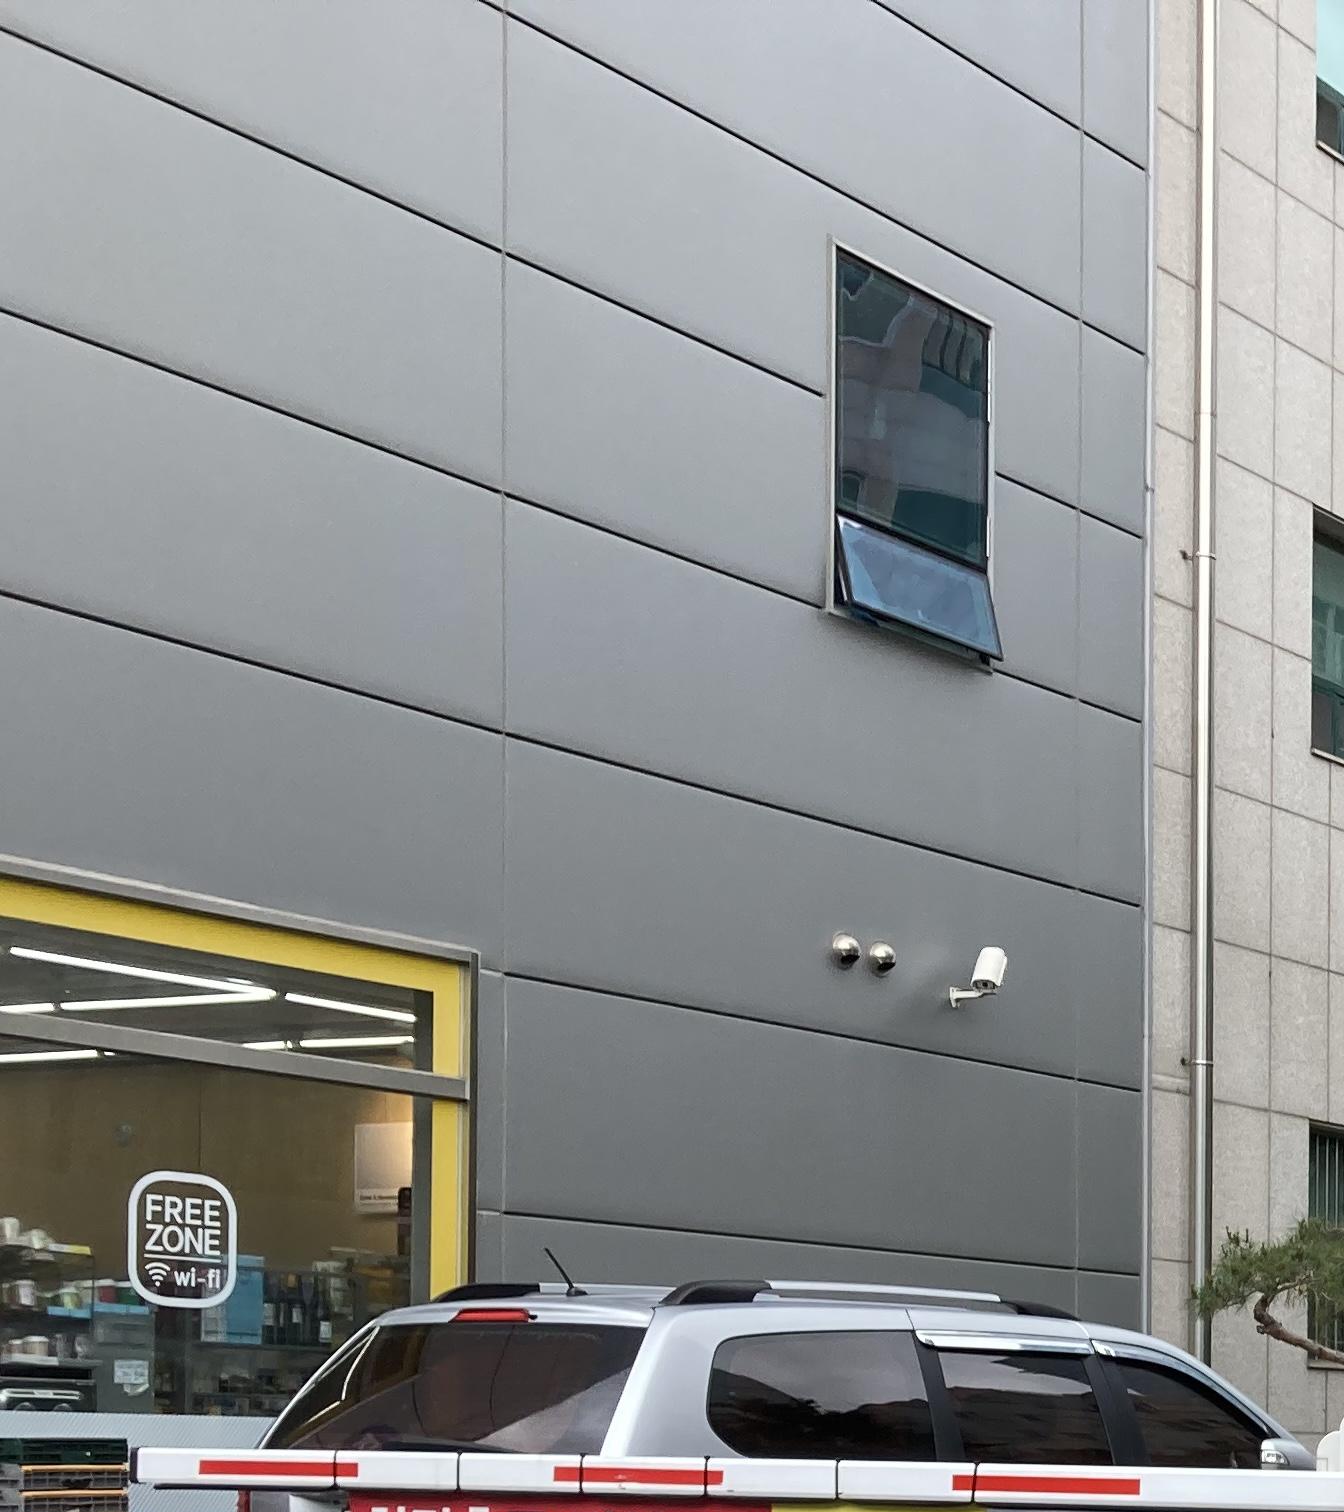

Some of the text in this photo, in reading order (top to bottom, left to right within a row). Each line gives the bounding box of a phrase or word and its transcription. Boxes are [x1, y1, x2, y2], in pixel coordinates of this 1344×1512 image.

[145, 1193, 221, 1227] FREE
[144, 1223, 221, 1256] ZONE
[174, 1267, 220, 1289] wi-fi
